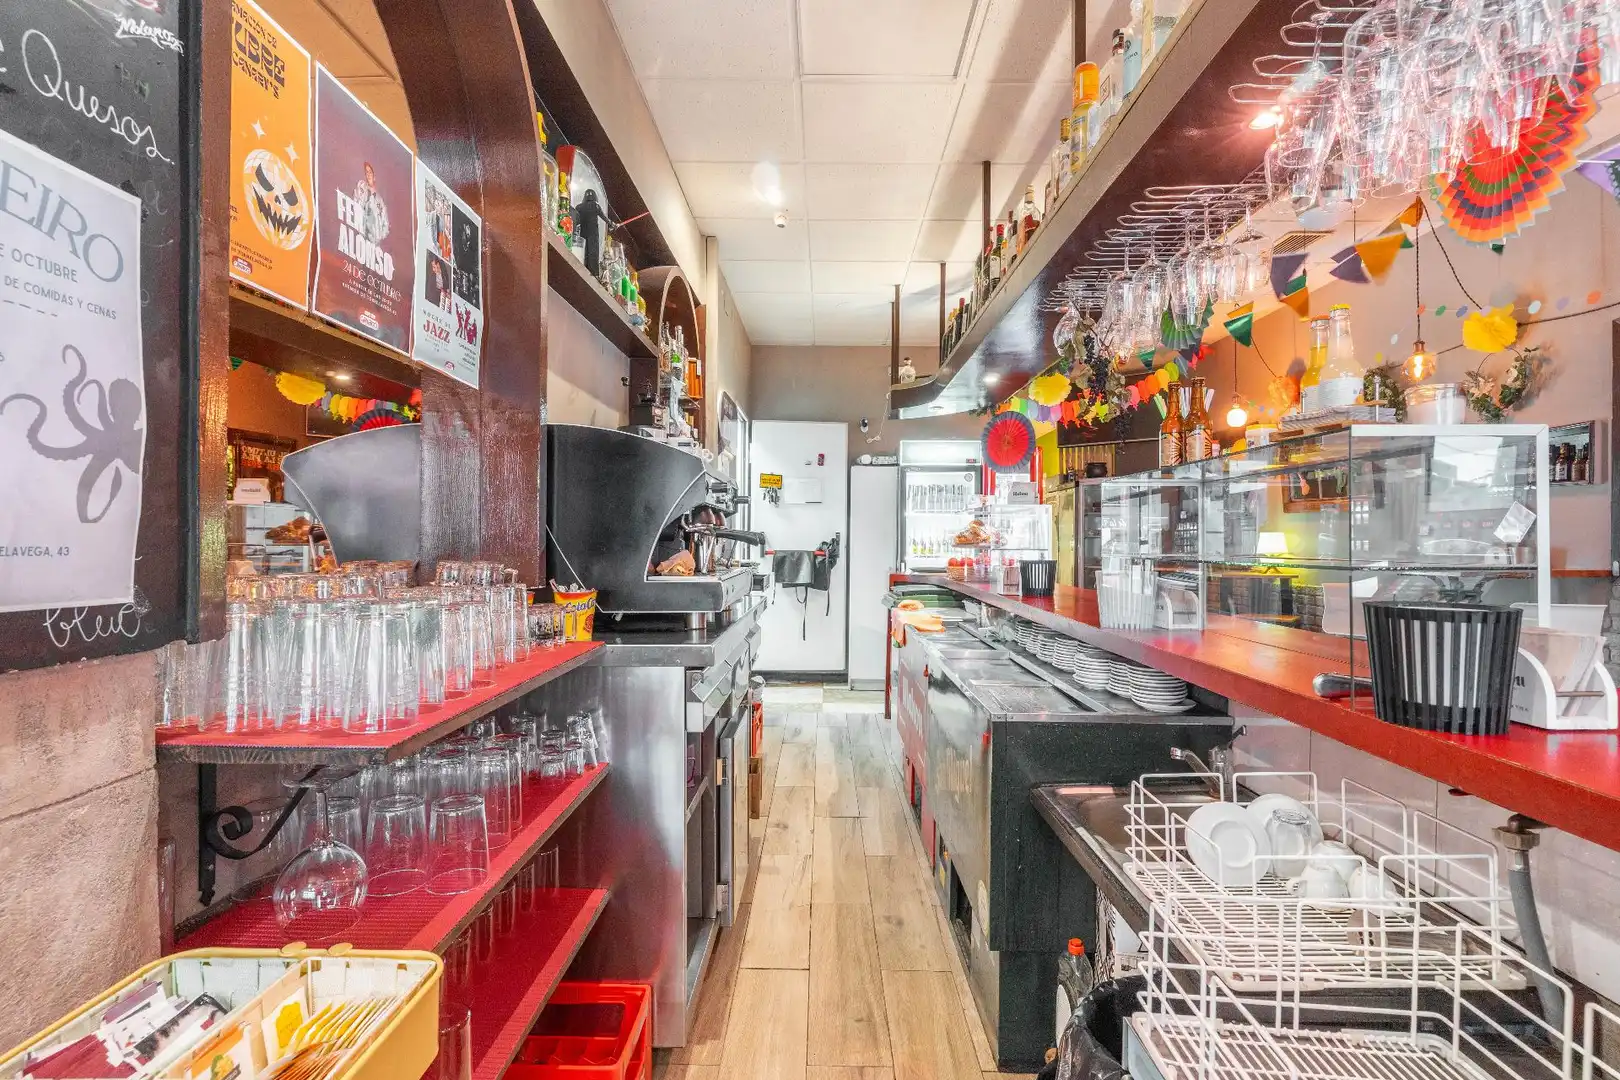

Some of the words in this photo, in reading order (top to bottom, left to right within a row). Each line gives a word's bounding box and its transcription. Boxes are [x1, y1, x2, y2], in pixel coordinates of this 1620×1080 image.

[232, 16, 285, 88] UBRE
[11, 248, 79, 284] OCTUBRE
[337, 222, 395, 281] ALONSO
[4, 275, 20, 289] DE
[23, 282, 74, 306] COMIDAS
[76, 298, 84, 309] Y
[86, 302, 117, 320] CENAS
[423, 320, 451, 344] JAZZ
[56, 546, 70, 556] 43
